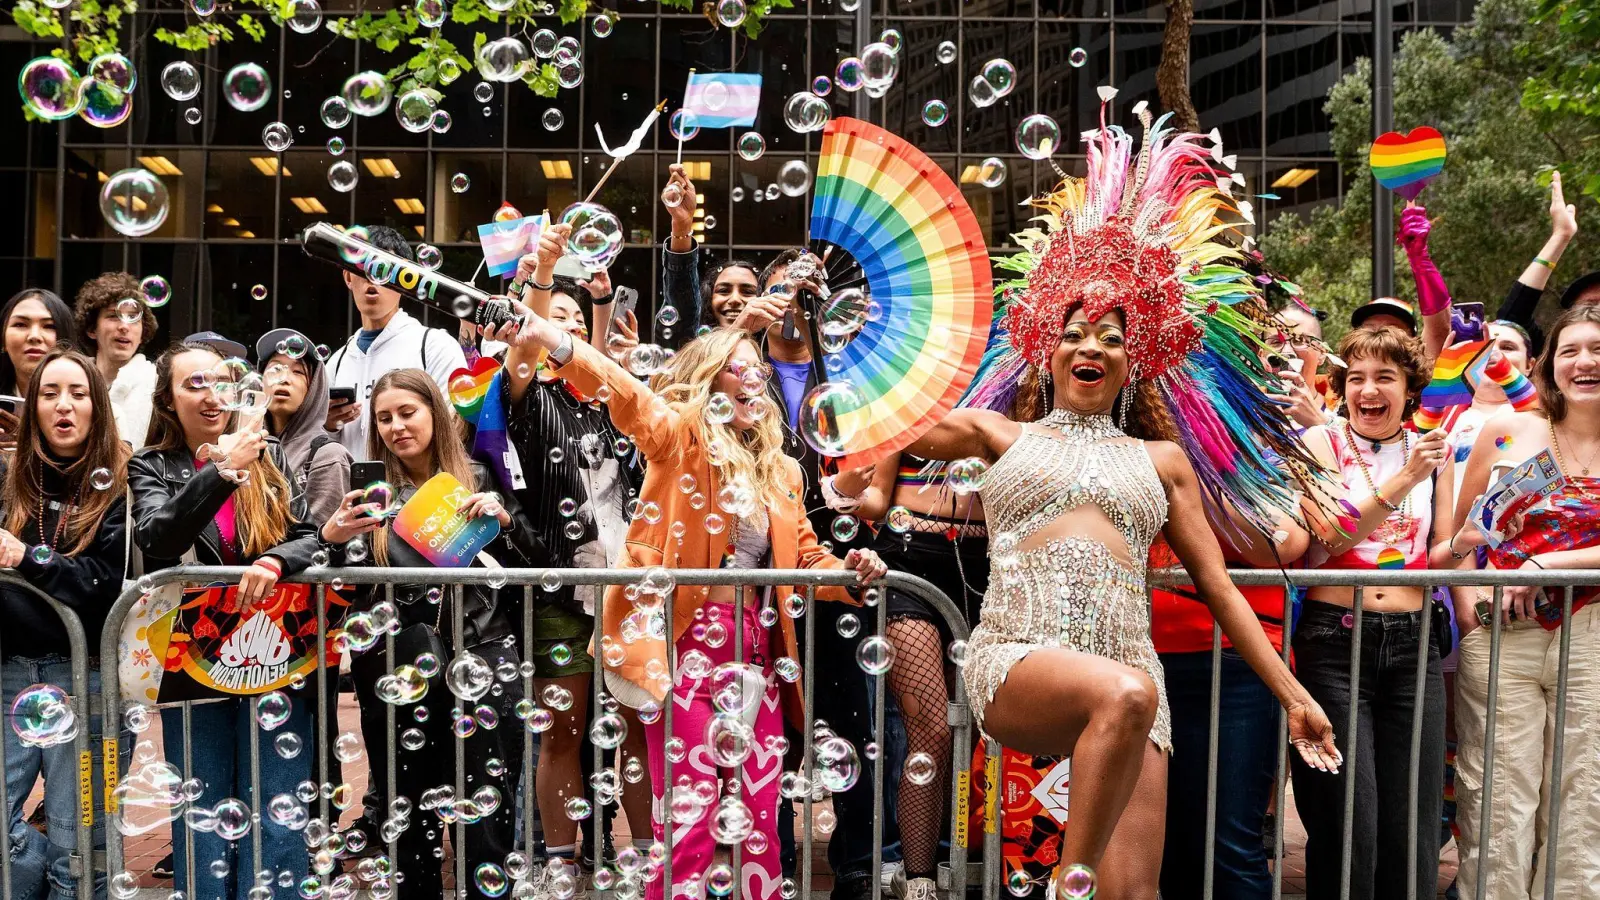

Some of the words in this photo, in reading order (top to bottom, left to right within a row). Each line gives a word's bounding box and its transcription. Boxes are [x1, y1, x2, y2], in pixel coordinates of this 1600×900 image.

[1539, 477, 1563, 496] PRID
[411, 504, 448, 543] PRESS
[428, 531, 444, 549] ON
[457, 537, 475, 557] GILEAD
[220, 608, 291, 668] AMOR
[207, 660, 290, 690] REVOLUCIÓN
